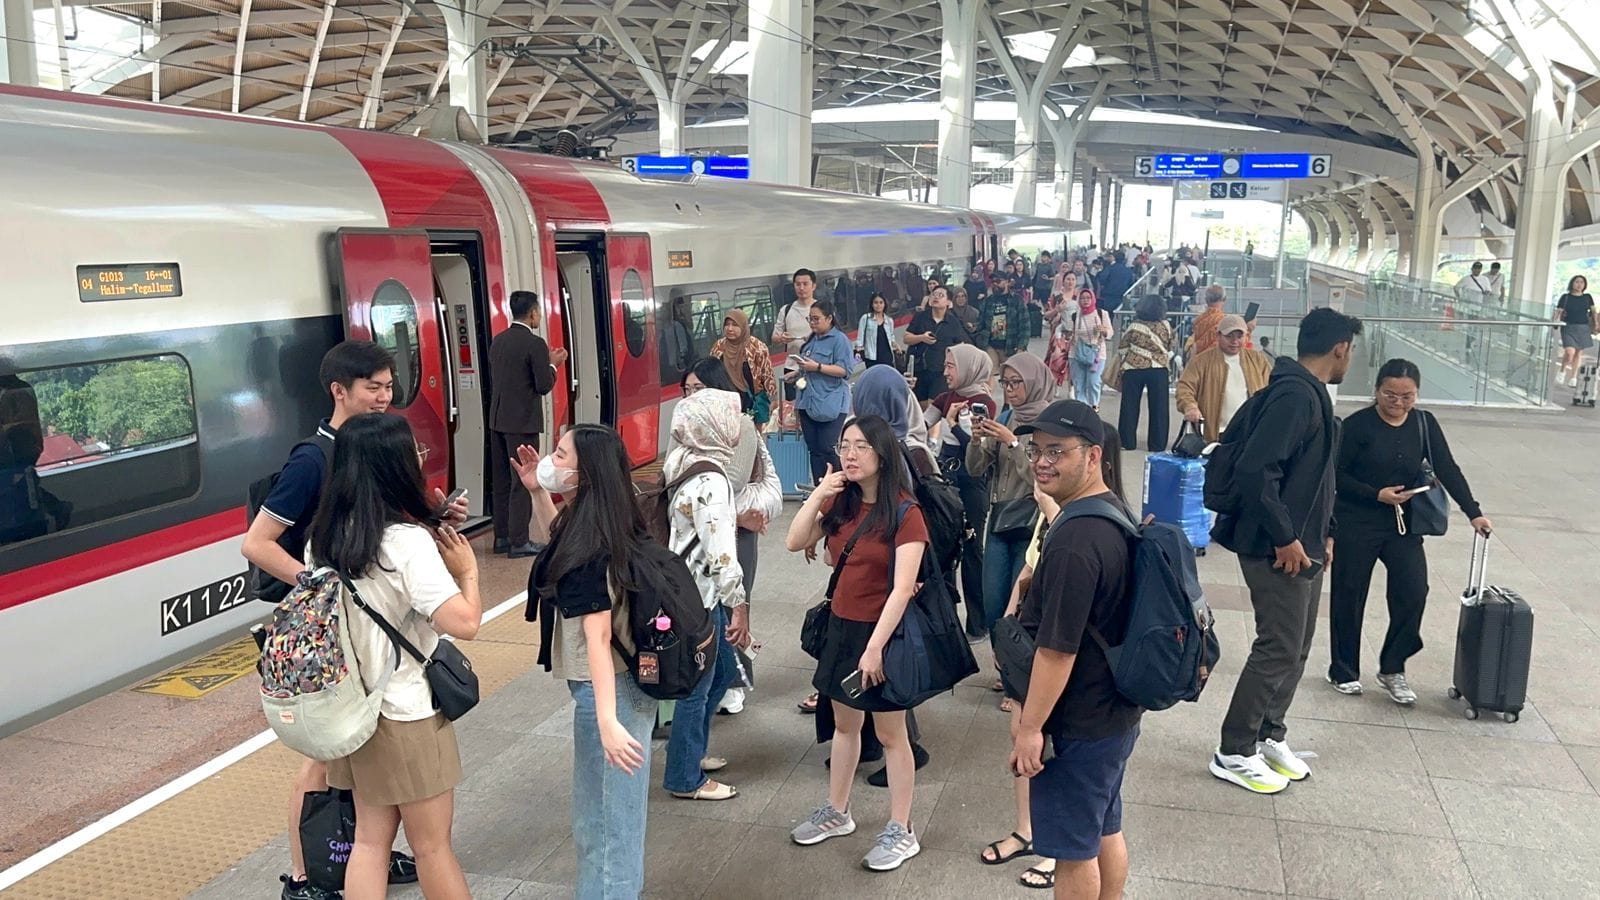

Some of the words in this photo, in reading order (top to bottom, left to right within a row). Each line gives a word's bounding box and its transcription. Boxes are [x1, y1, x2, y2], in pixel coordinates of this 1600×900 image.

[624, 159, 636, 172] 3
[1140, 158, 1152, 174] 5
[1312, 158, 1326, 174] 6
[99, 271, 124, 282] G1013
[81, 278, 93, 290] 04
